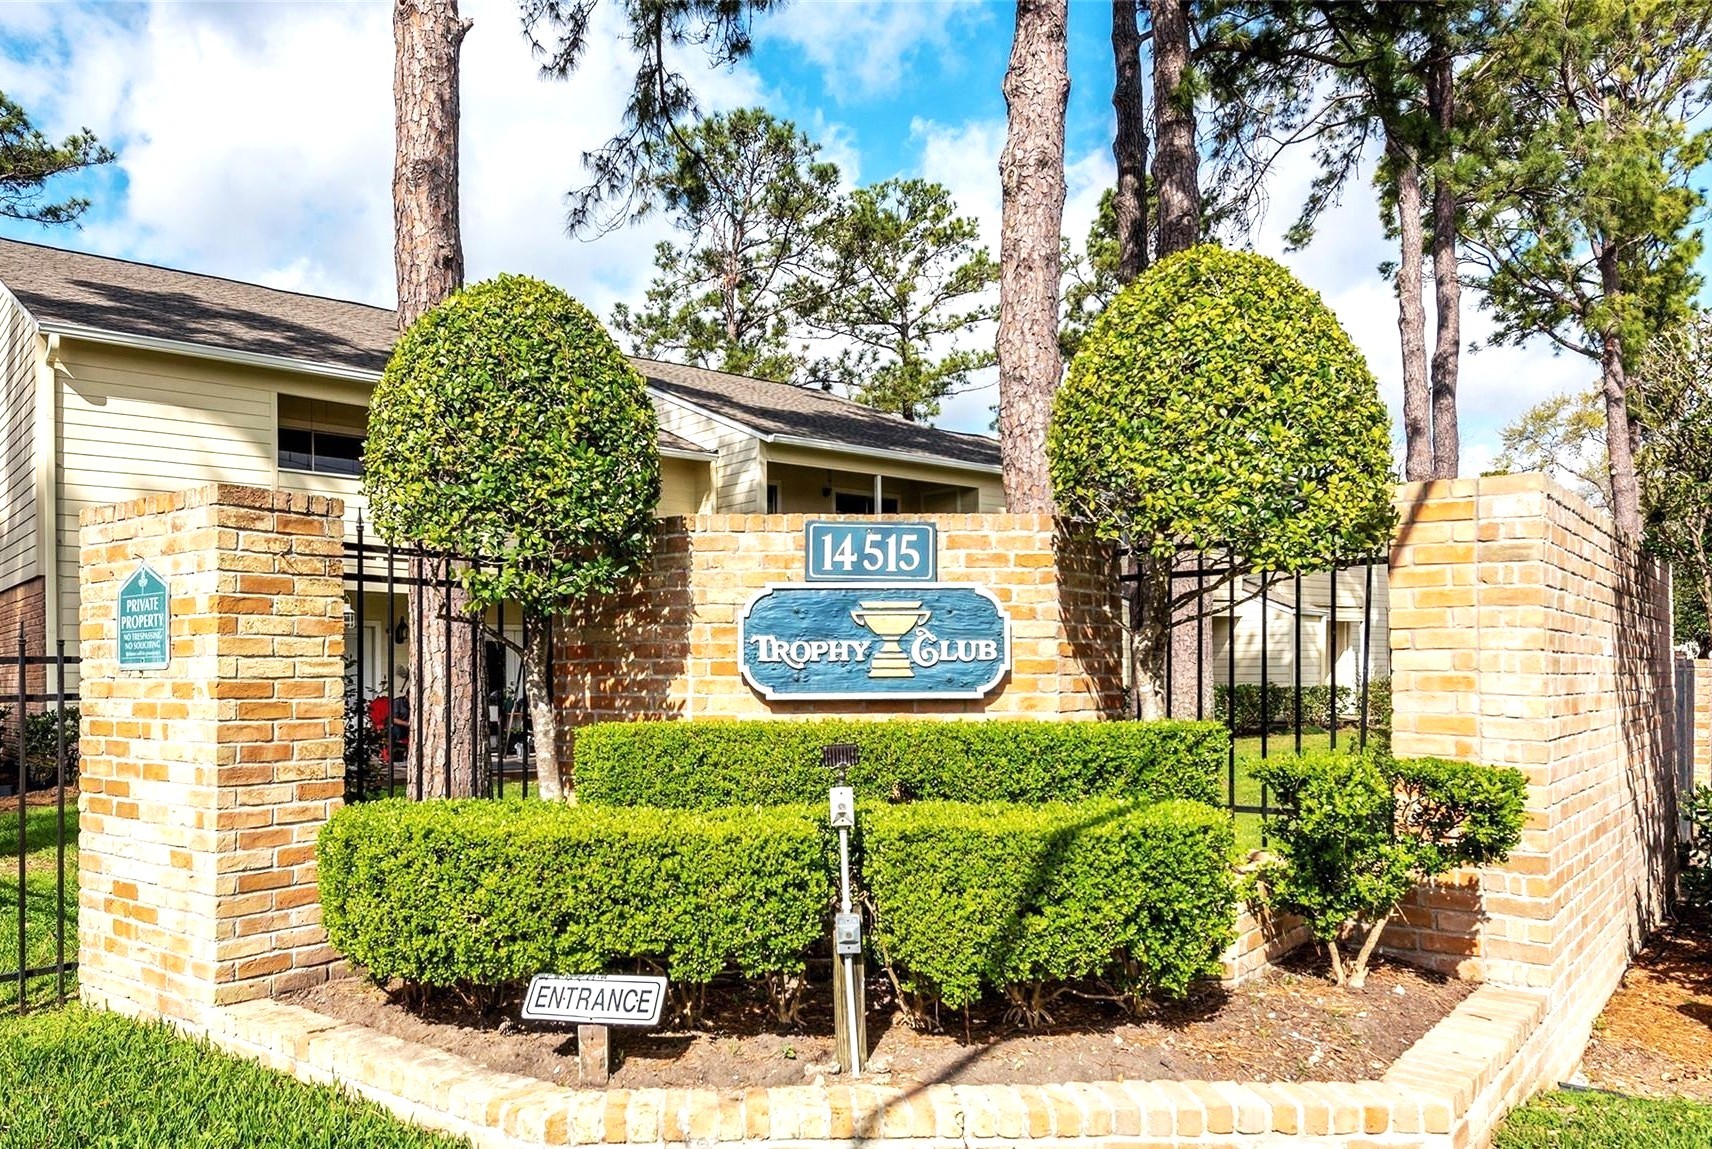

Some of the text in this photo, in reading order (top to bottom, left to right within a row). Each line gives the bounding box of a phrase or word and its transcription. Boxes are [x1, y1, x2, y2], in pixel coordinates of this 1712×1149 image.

[126, 597, 159, 612] PRIVATE
[121, 613, 164, 629] PROPERTY
[123, 633, 131, 641] NO
[125, 642, 133, 650] NO
[750, 627, 998, 670] TROPHY CLUB
[534, 985, 653, 1013] ENTRANCE
